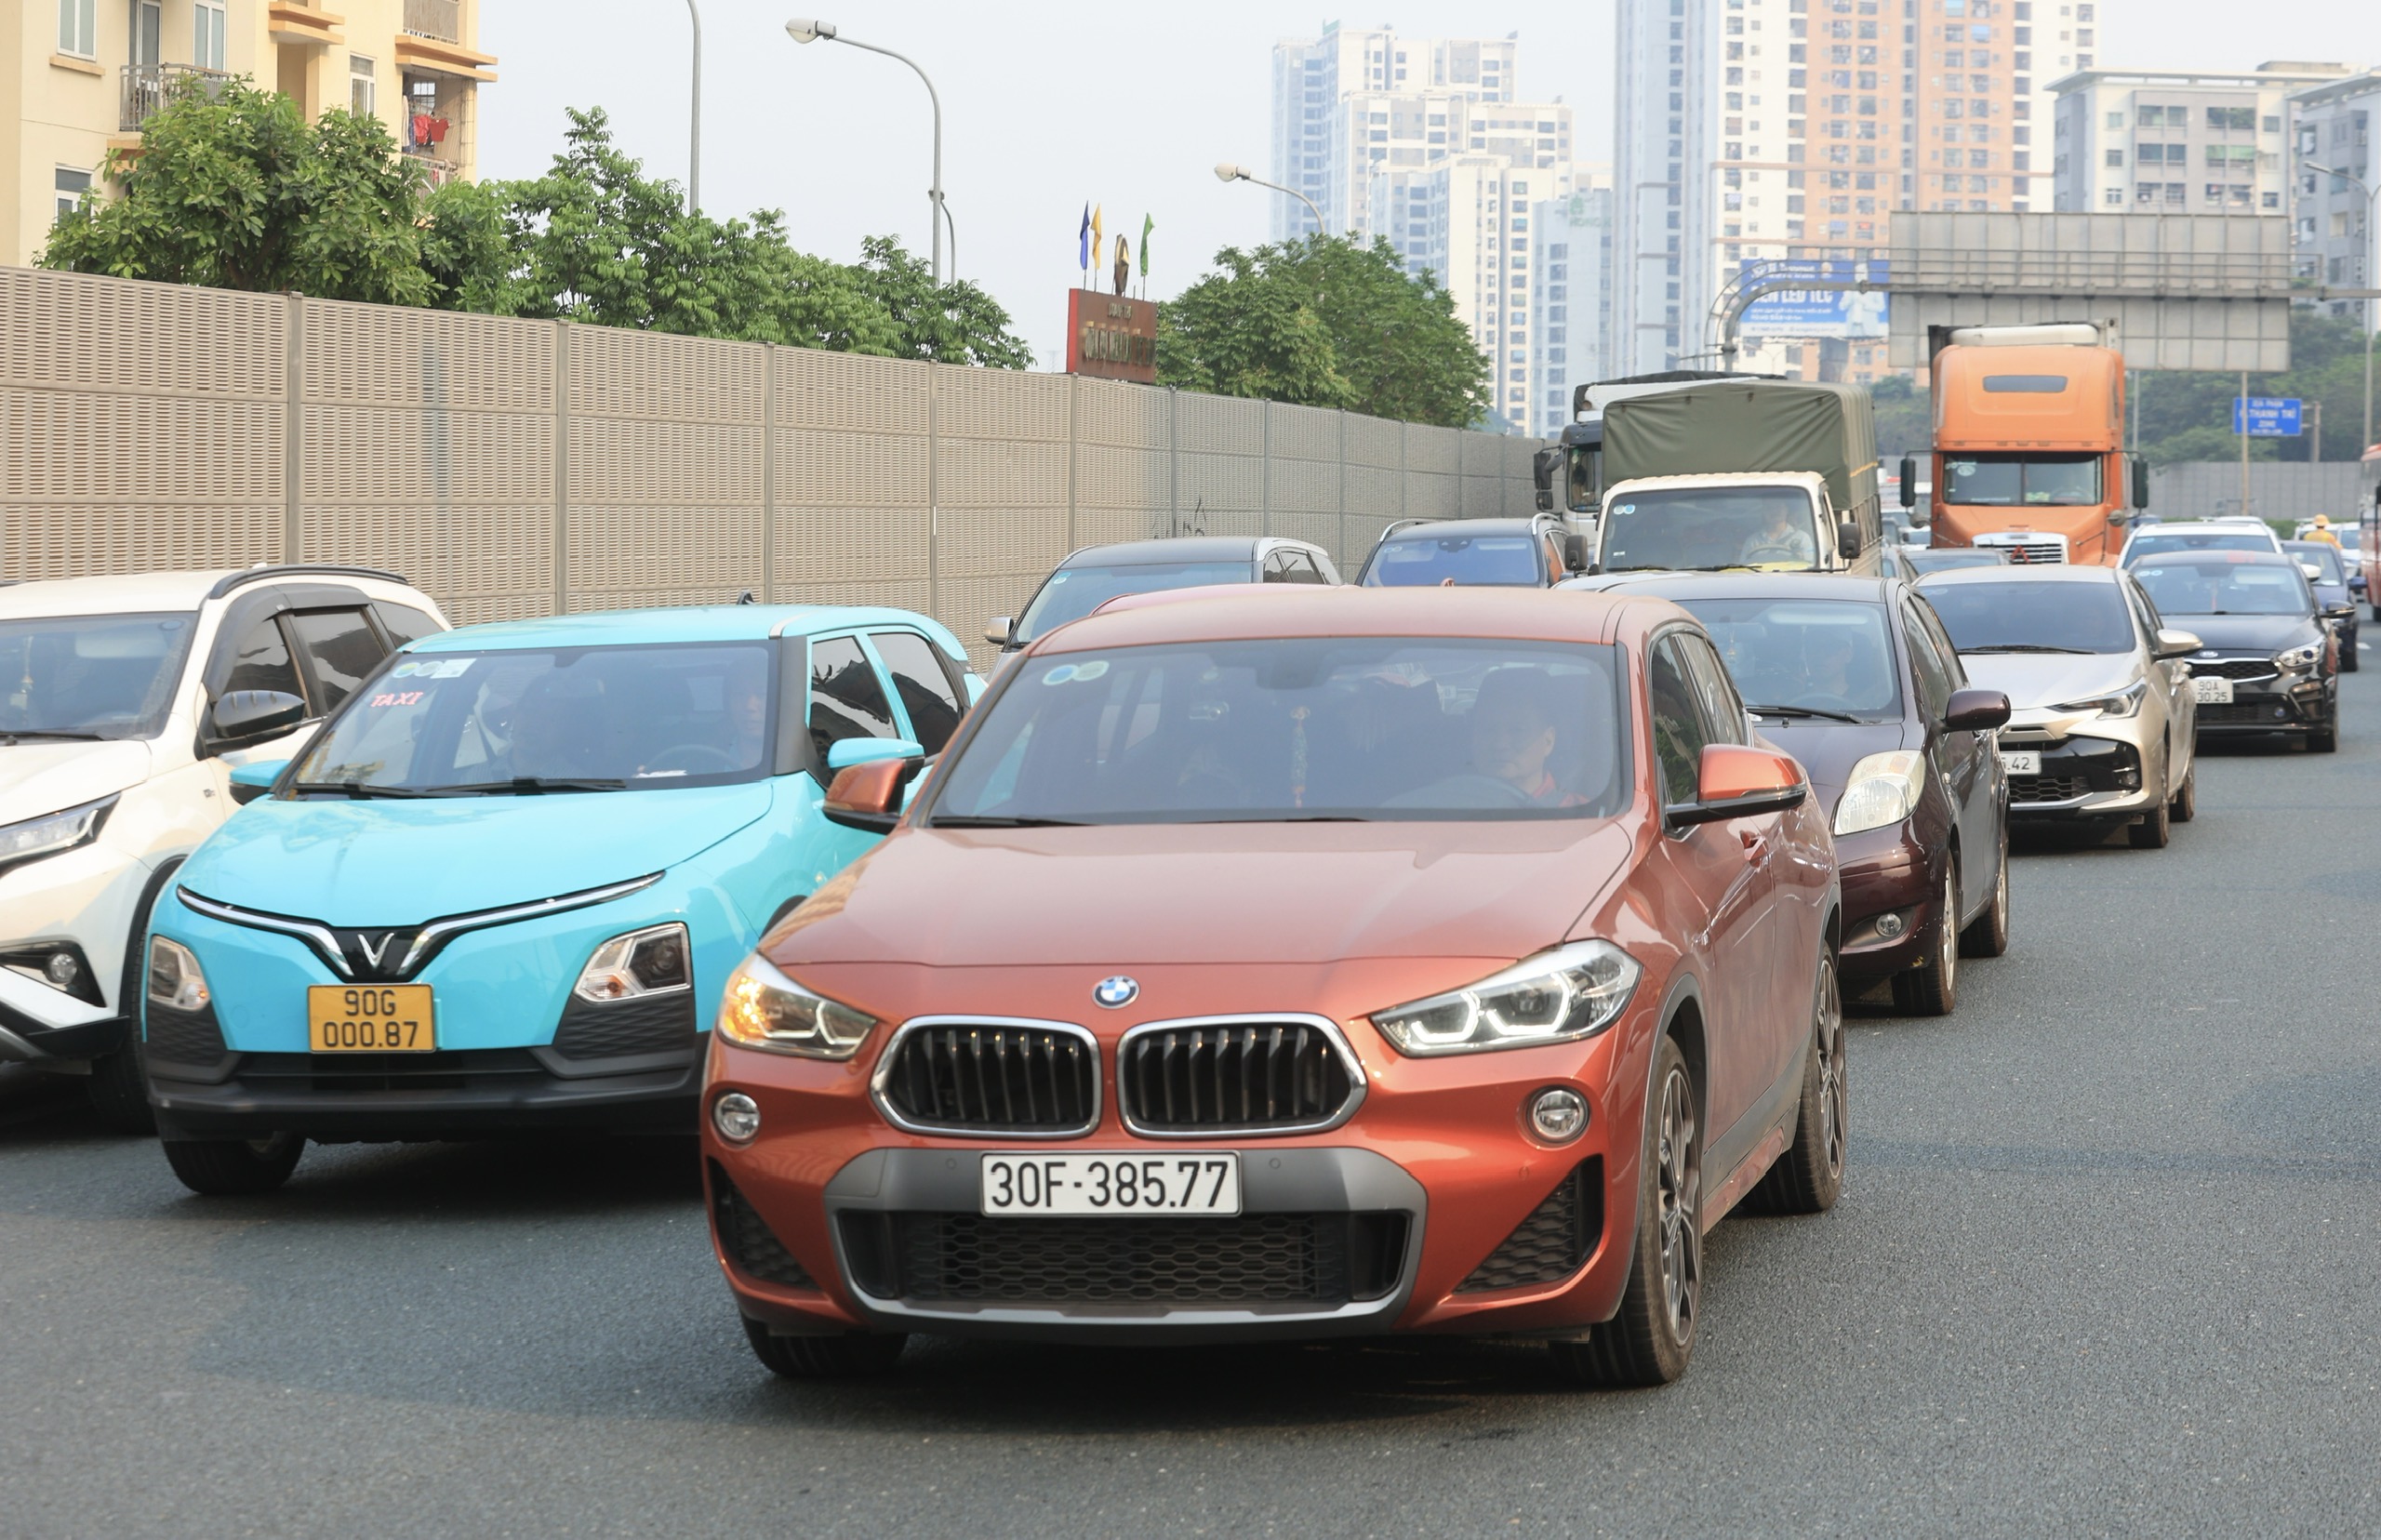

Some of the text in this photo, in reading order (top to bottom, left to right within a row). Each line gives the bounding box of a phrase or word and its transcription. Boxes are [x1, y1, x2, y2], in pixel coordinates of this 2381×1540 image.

[370, 691, 424, 708] TAXI
[2197, 691, 2228, 702] 30.25
[344, 989, 396, 1016] 90G
[324, 1021, 419, 1048] 000.87
[991, 1161, 1229, 1208] 30F-385.77
